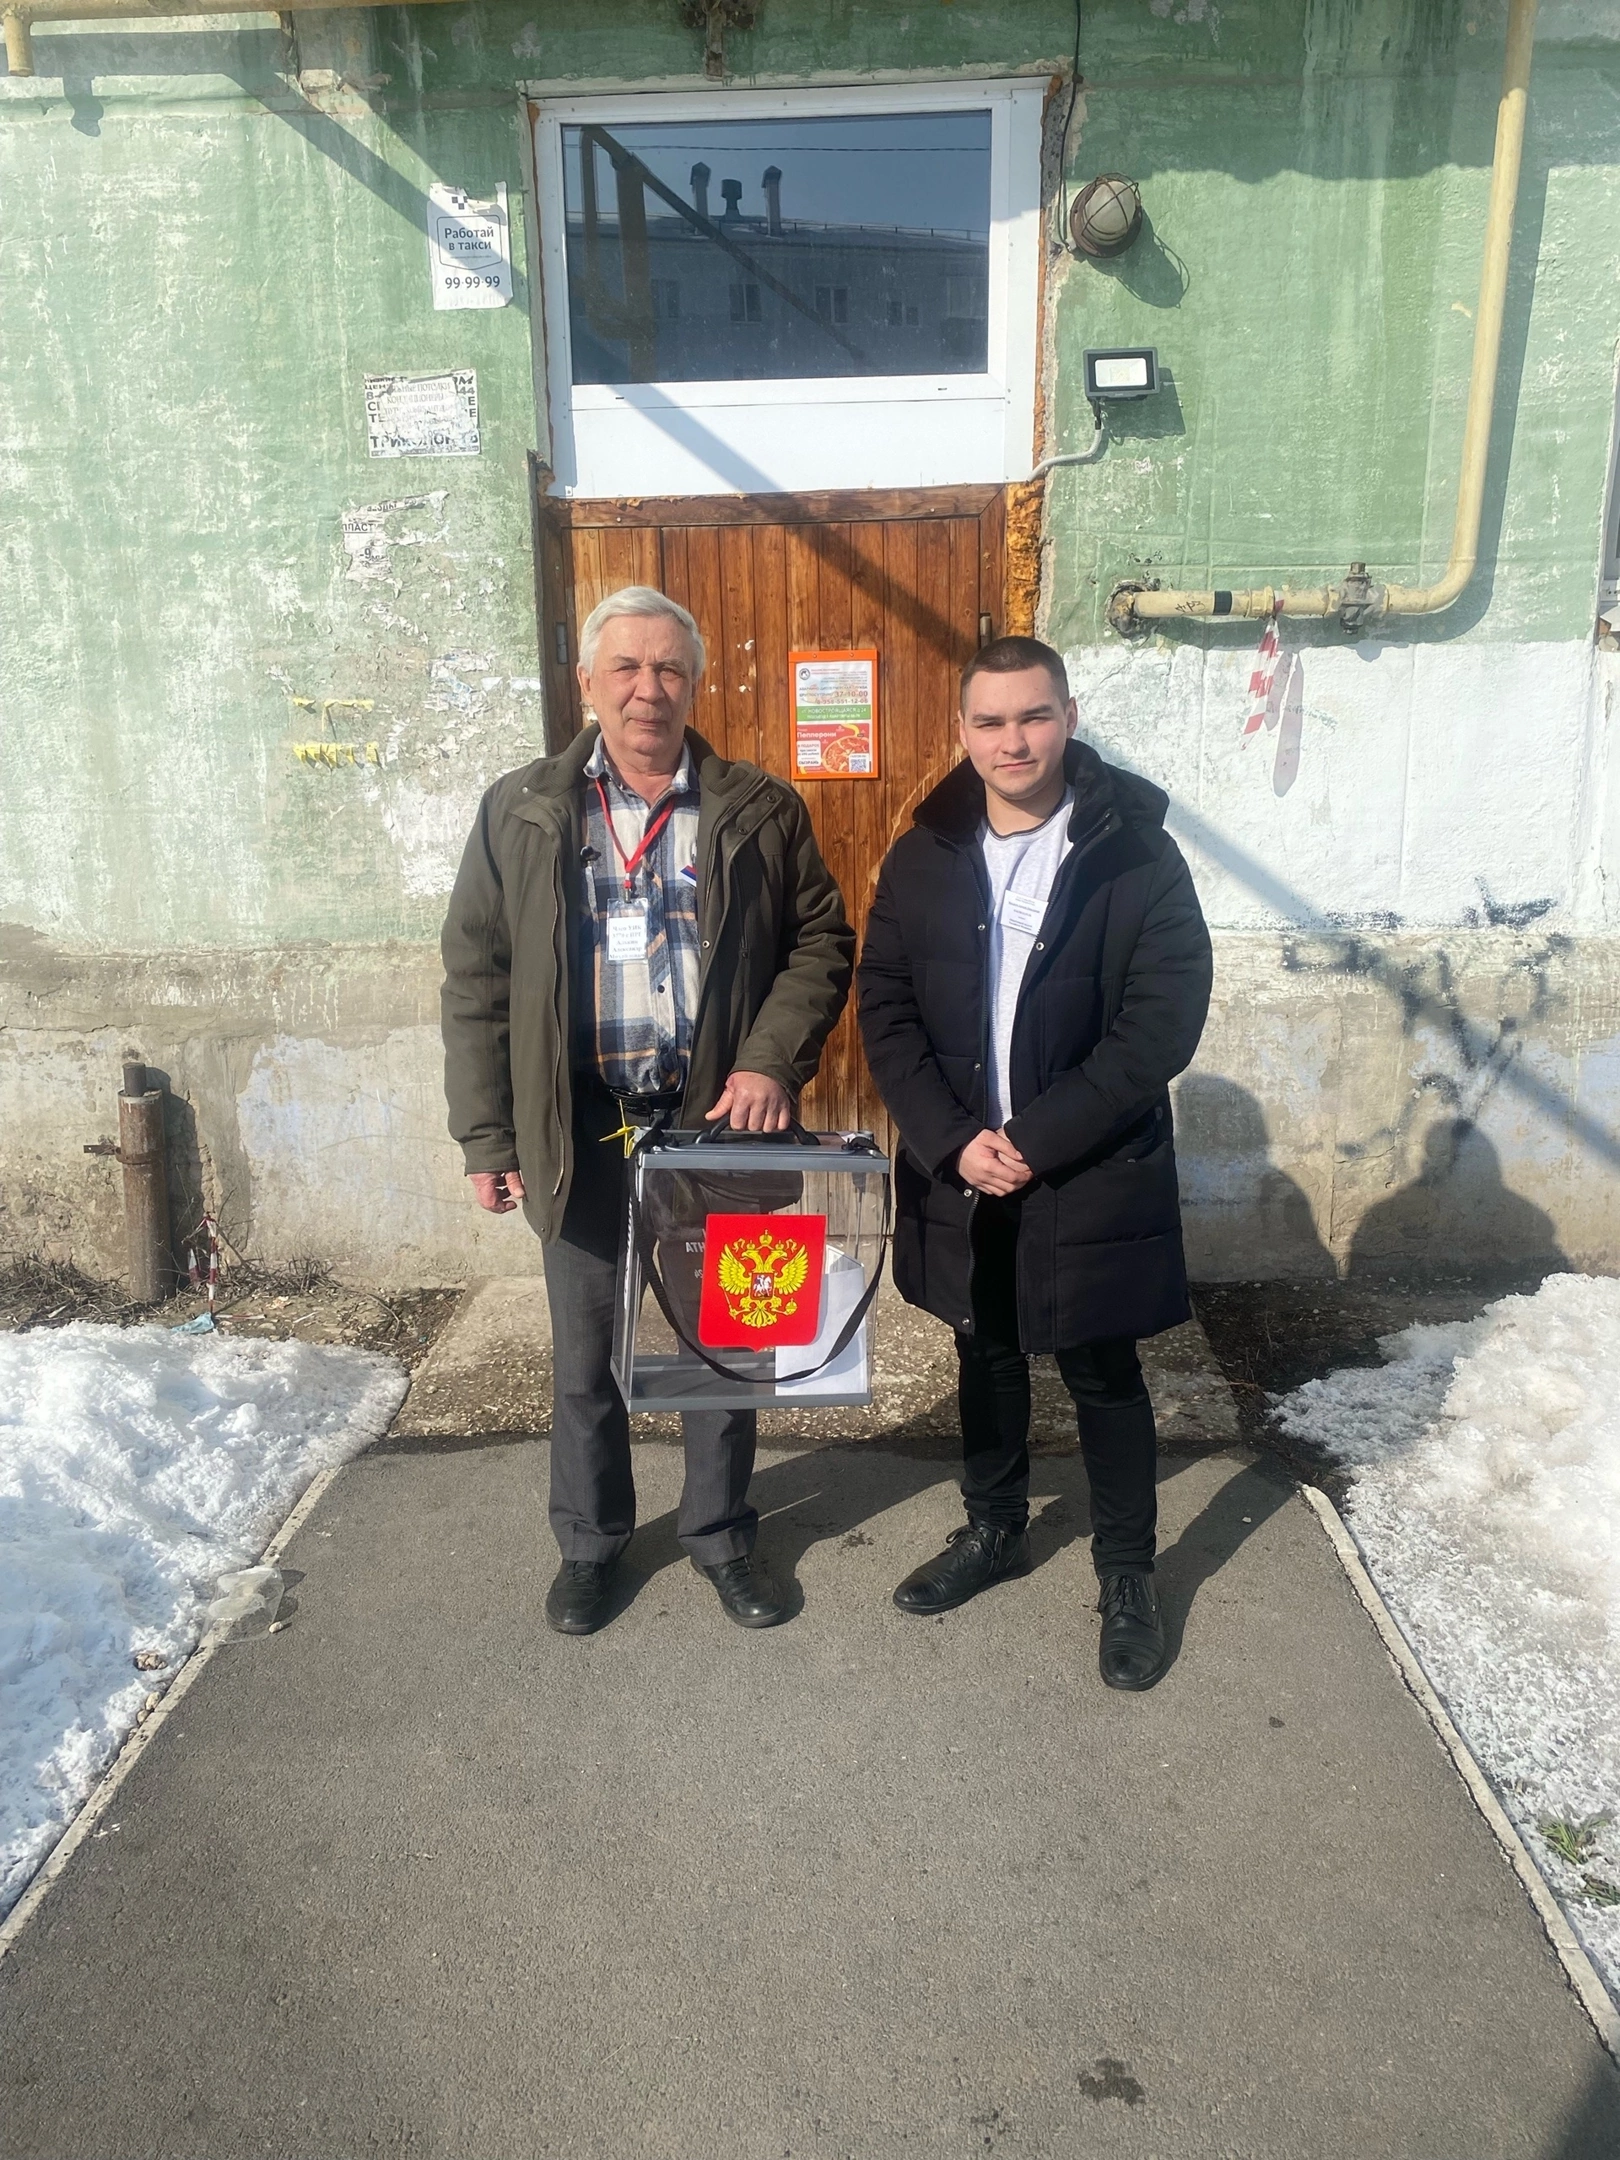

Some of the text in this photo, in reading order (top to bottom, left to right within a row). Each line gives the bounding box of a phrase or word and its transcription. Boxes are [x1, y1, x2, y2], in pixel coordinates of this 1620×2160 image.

[444, 226, 494, 239] Работай
[448, 241, 492, 251] в такси
